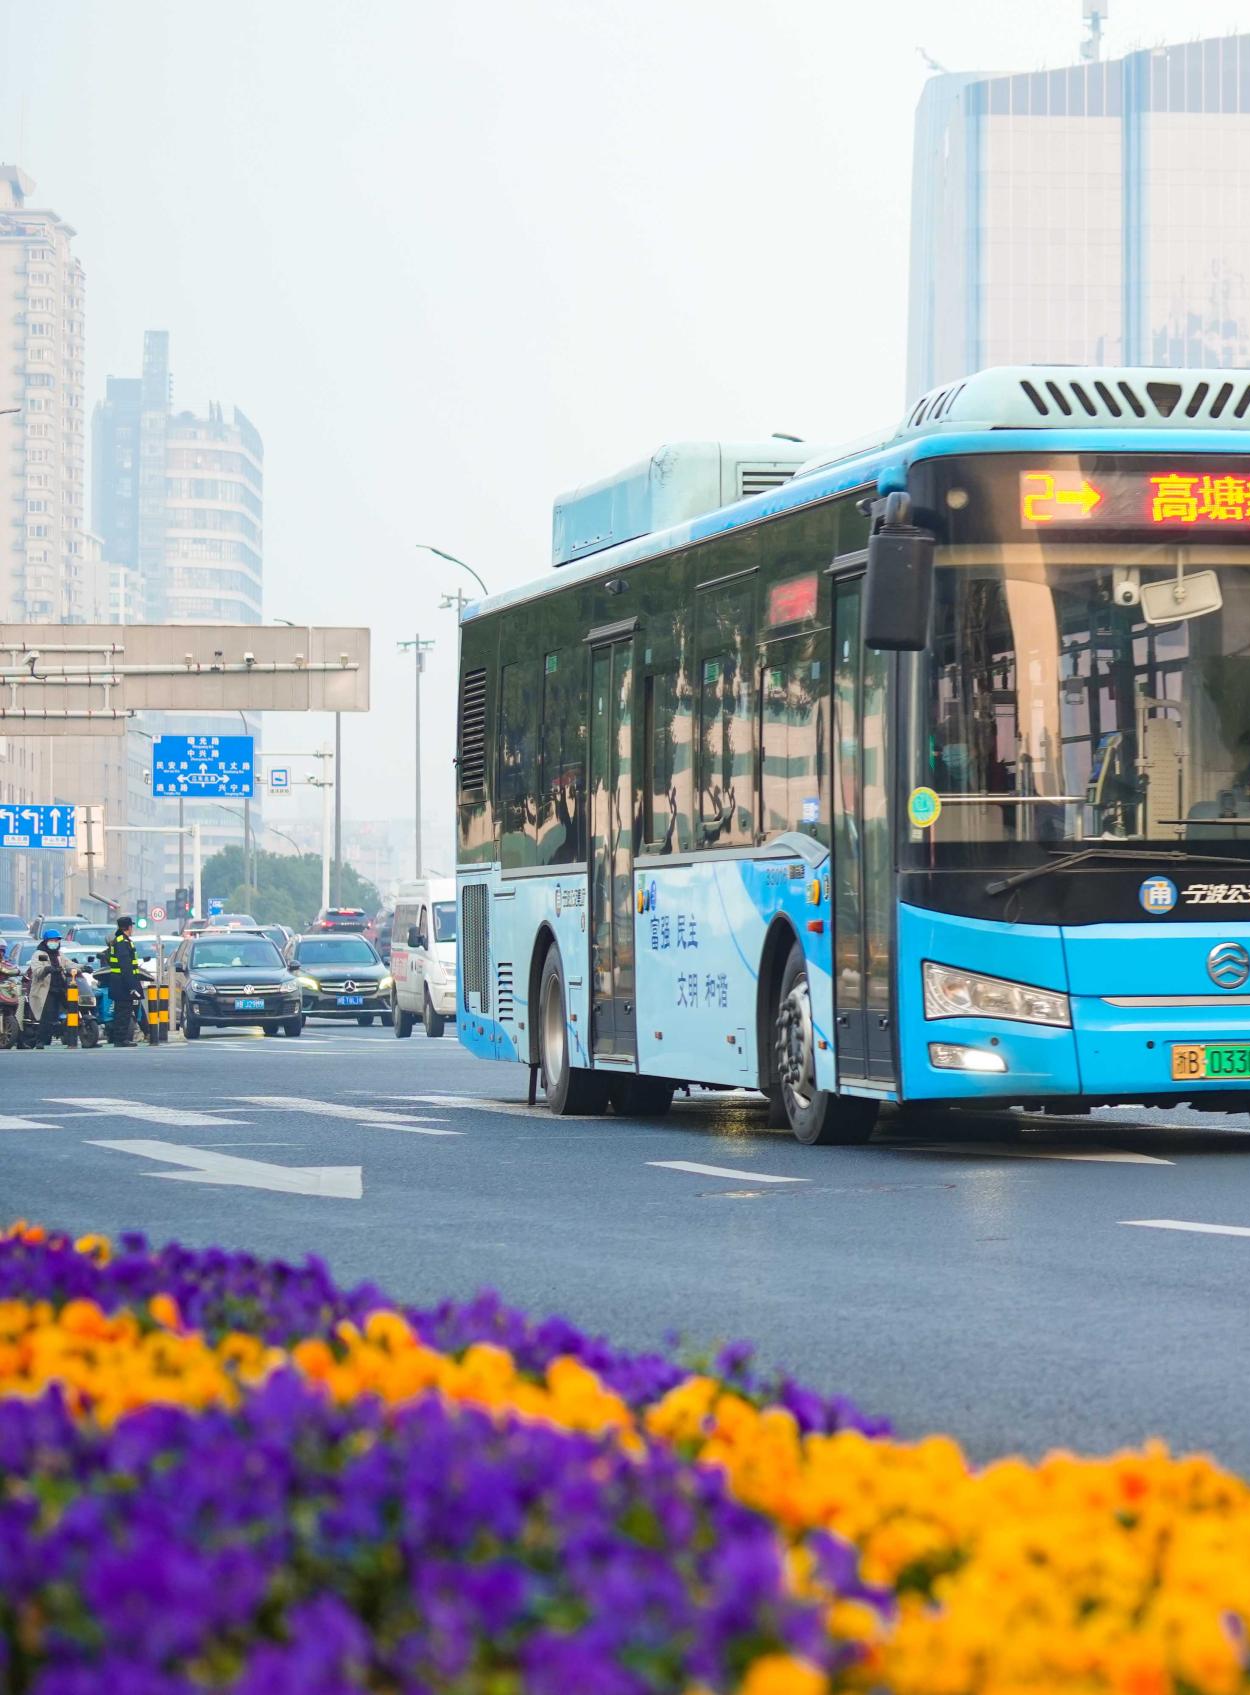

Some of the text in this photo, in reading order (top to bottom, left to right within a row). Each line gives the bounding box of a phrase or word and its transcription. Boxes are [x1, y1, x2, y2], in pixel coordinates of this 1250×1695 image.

[1024, 474, 1055, 521] 2
[153, 909, 163, 918] 60
[650, 912, 698, 951] 富强 民主
[677, 972, 728, 1009] 文明 和谐
